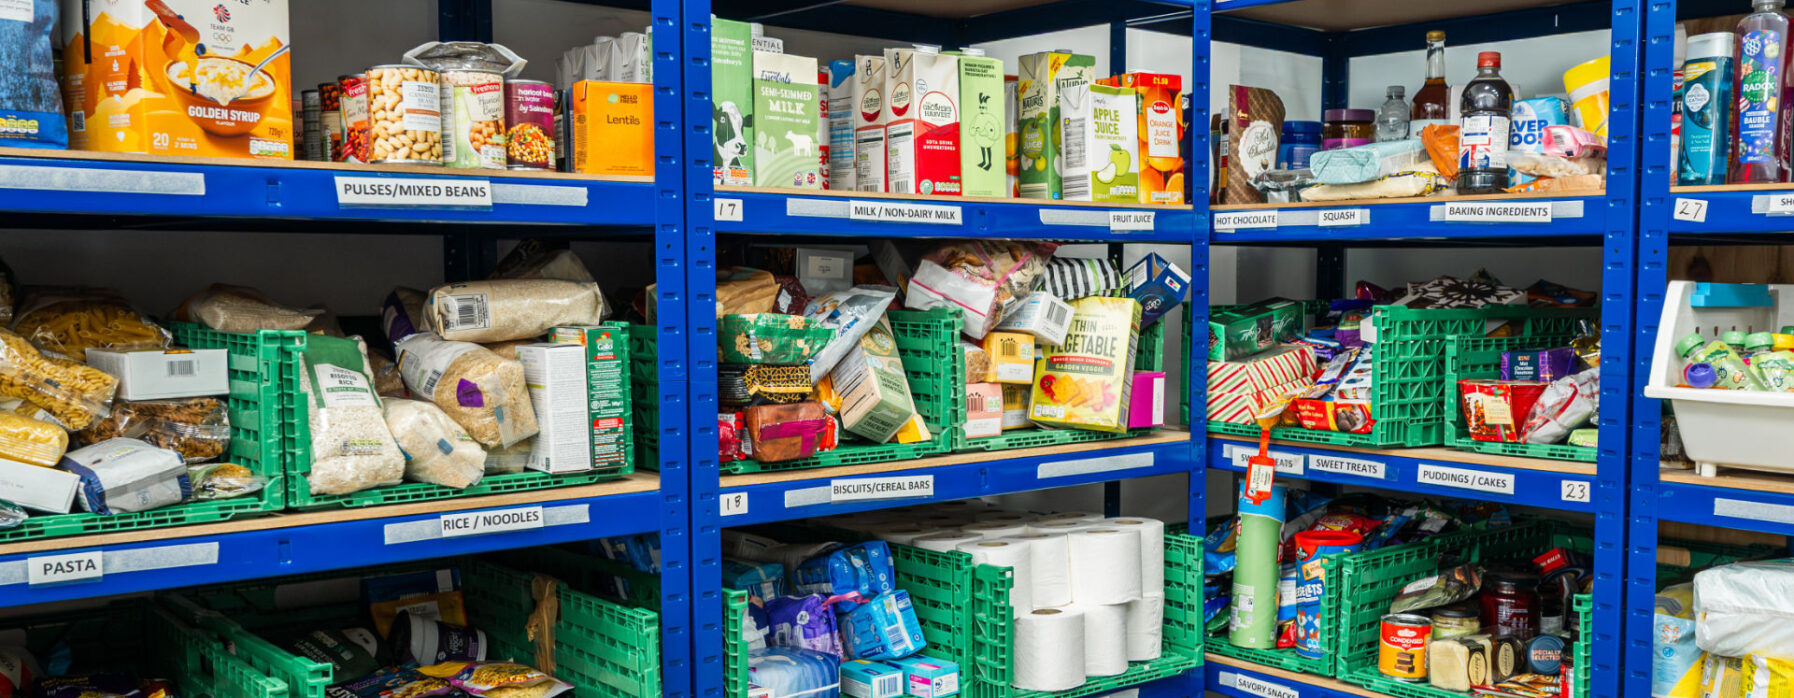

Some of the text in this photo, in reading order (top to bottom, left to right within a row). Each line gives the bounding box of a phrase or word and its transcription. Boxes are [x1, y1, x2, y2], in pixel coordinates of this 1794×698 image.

[752, 39, 781, 49] ENTIAL
[760, 86, 812, 100] SEMI-SKIMMED
[188, 106, 261, 122] GOLDEN SYRUP
[768, 99, 806, 115] MILK
[606, 114, 640, 125] Lentils
[1094, 107, 1120, 122] APPLE
[1094, 121, 1119, 135] JUICE
[1149, 119, 1173, 128] ORANGE
[153, 132, 169, 146] 20
[1154, 137, 1171, 145] DRINK
[344, 183, 487, 198] PULSES/MIXED BEANS
[1781, 197, 1794, 206] SH
[854, 205, 877, 217] MILK
[884, 207, 933, 219] NON-DAIRY
[934, 209, 955, 220] MILK
[1323, 211, 1356, 221] SQUASH
[1449, 207, 1549, 217] BAKING INGREDIENTS
[1678, 201, 1703, 219] 27
[1112, 214, 1152, 224] FRUIT JUICE
[1216, 215, 1276, 225] HOT CHOCOLATE
[1074, 319, 1097, 333] THIN
[1275, 459, 1293, 468] EATS
[1316, 458, 1378, 474] SWEET TREATS
[1423, 470, 1470, 485] PUDDINGS
[1478, 476, 1507, 488] CAKES
[833, 479, 930, 495] BISCUITS/CEREAL BARS
[1565, 483, 1587, 499] 23
[726, 494, 742, 511] 18
[443, 517, 470, 530] RICE
[483, 510, 540, 526] NOODLES
[43, 558, 97, 576] PASTA
[1389, 636, 1424, 644] CONDENSED
[1238, 678, 1267, 693] SAVORY
